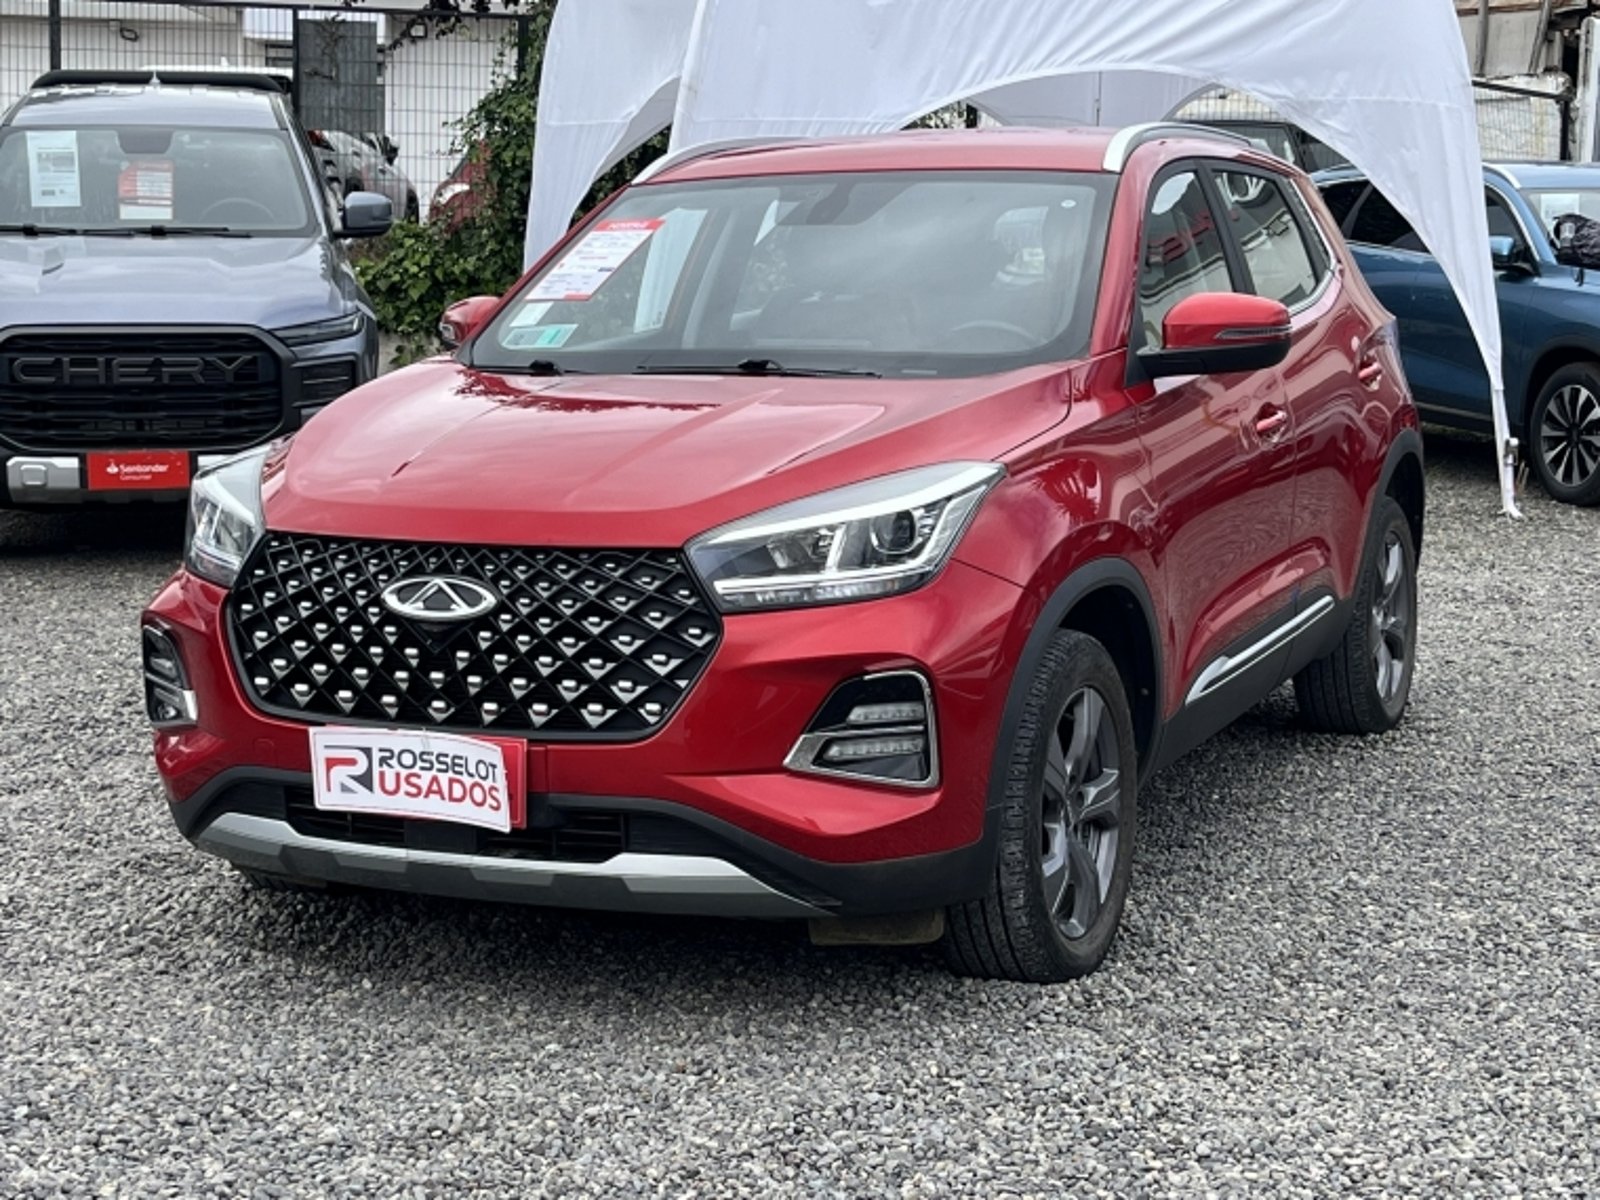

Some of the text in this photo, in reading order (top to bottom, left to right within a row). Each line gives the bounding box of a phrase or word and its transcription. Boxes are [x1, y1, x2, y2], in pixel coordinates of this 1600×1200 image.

[12, 356, 254, 384] CHERY
[119, 464, 169, 473] Santander
[378, 747, 498, 783] ROSSELOT
[378, 770, 501, 812] USADOS
